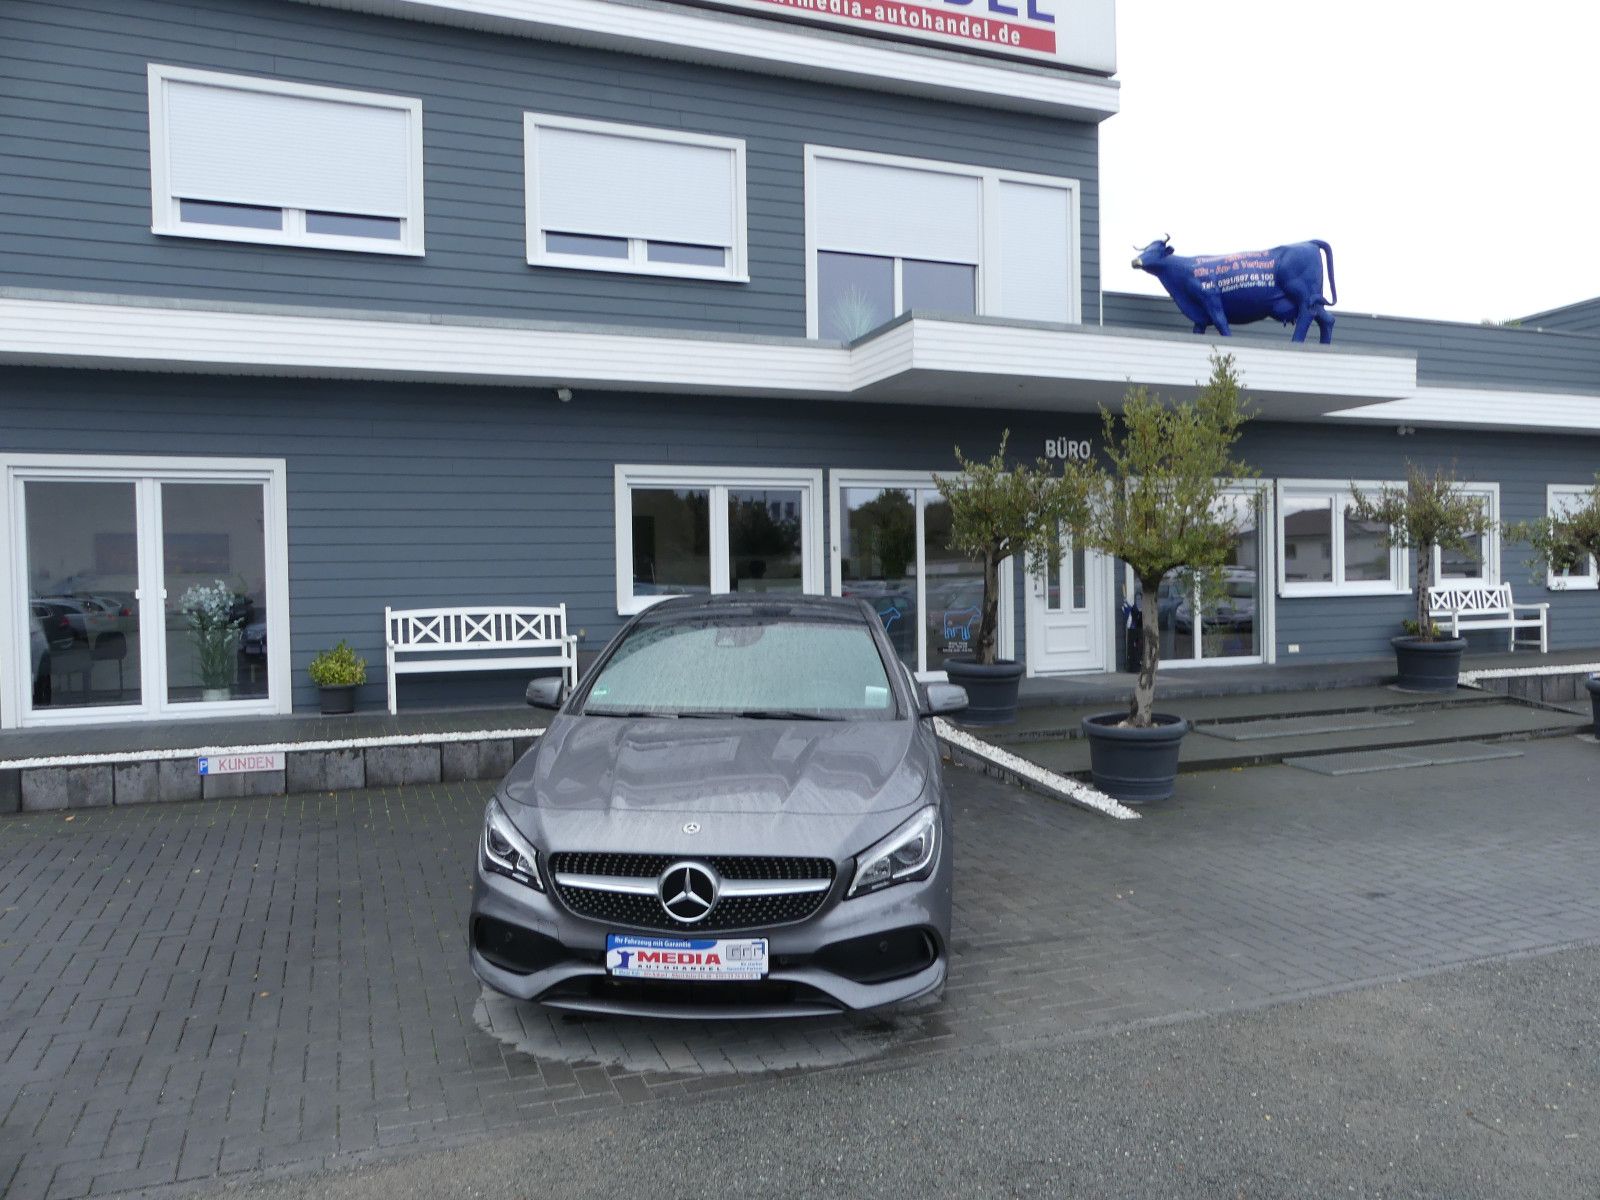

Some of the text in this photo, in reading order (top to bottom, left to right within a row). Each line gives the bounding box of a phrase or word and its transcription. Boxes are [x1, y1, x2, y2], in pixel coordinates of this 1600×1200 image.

[1045, 436, 1091, 460] BÜRO
[218, 756, 275, 771] KUNDEN
[614, 935, 692, 949] Ihr Fahrzeug mit Garantie
[637, 950, 721, 966] MEDIA
